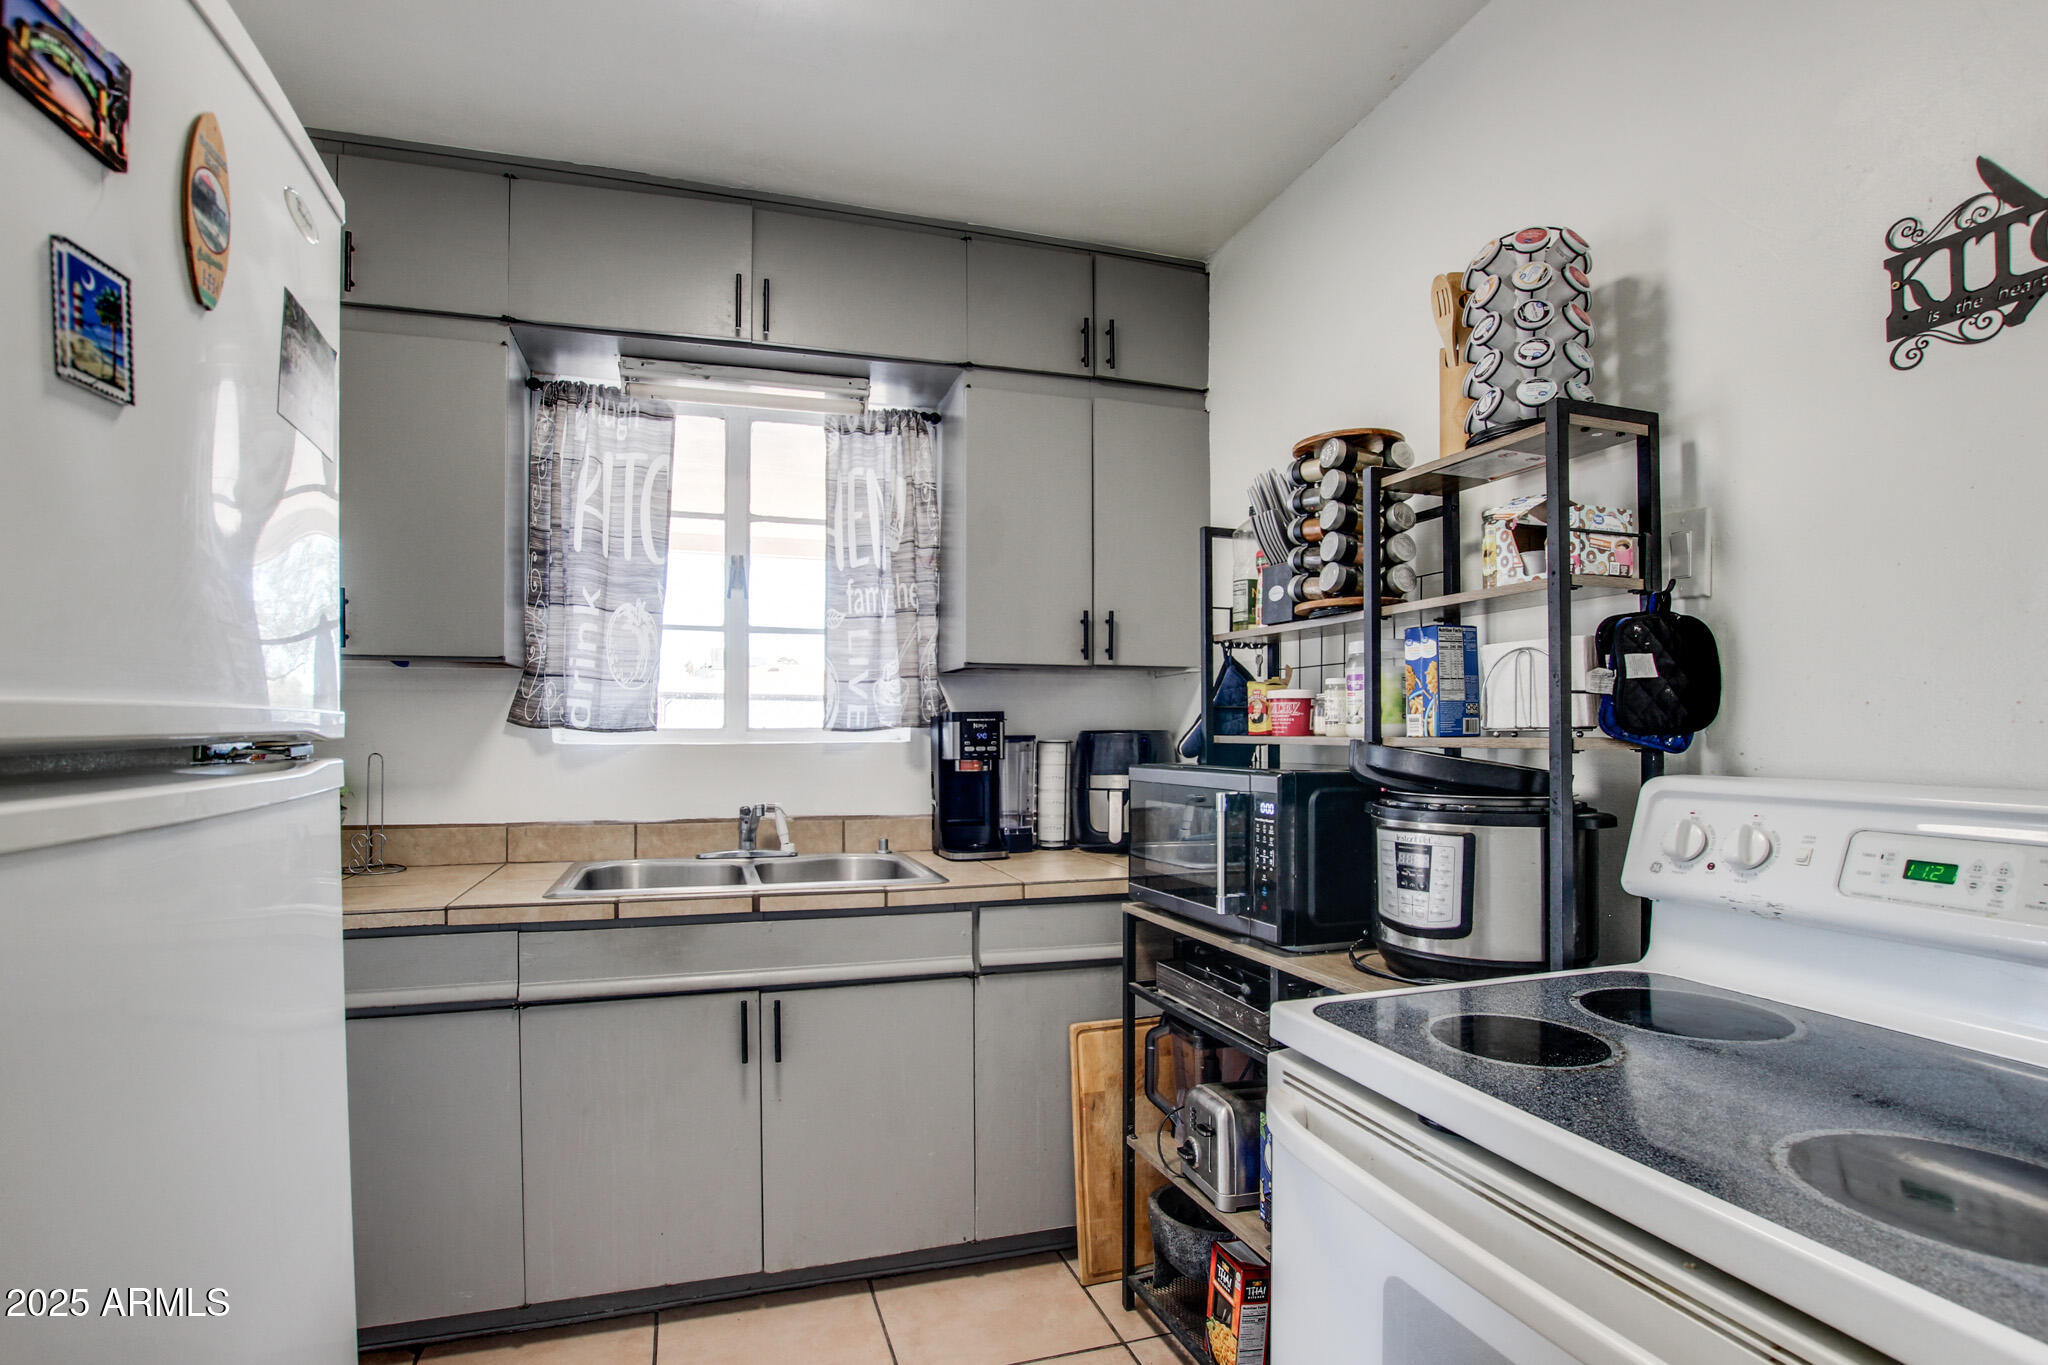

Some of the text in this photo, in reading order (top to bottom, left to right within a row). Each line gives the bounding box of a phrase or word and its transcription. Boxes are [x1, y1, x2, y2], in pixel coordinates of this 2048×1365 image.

[1926, 311, 1940, 323] is
[1955, 297, 1984, 314] the
[566, 586, 601, 729] drink
[847, 629, 871, 729] LIVE
[1246, 1286, 1267, 1297] THAI
